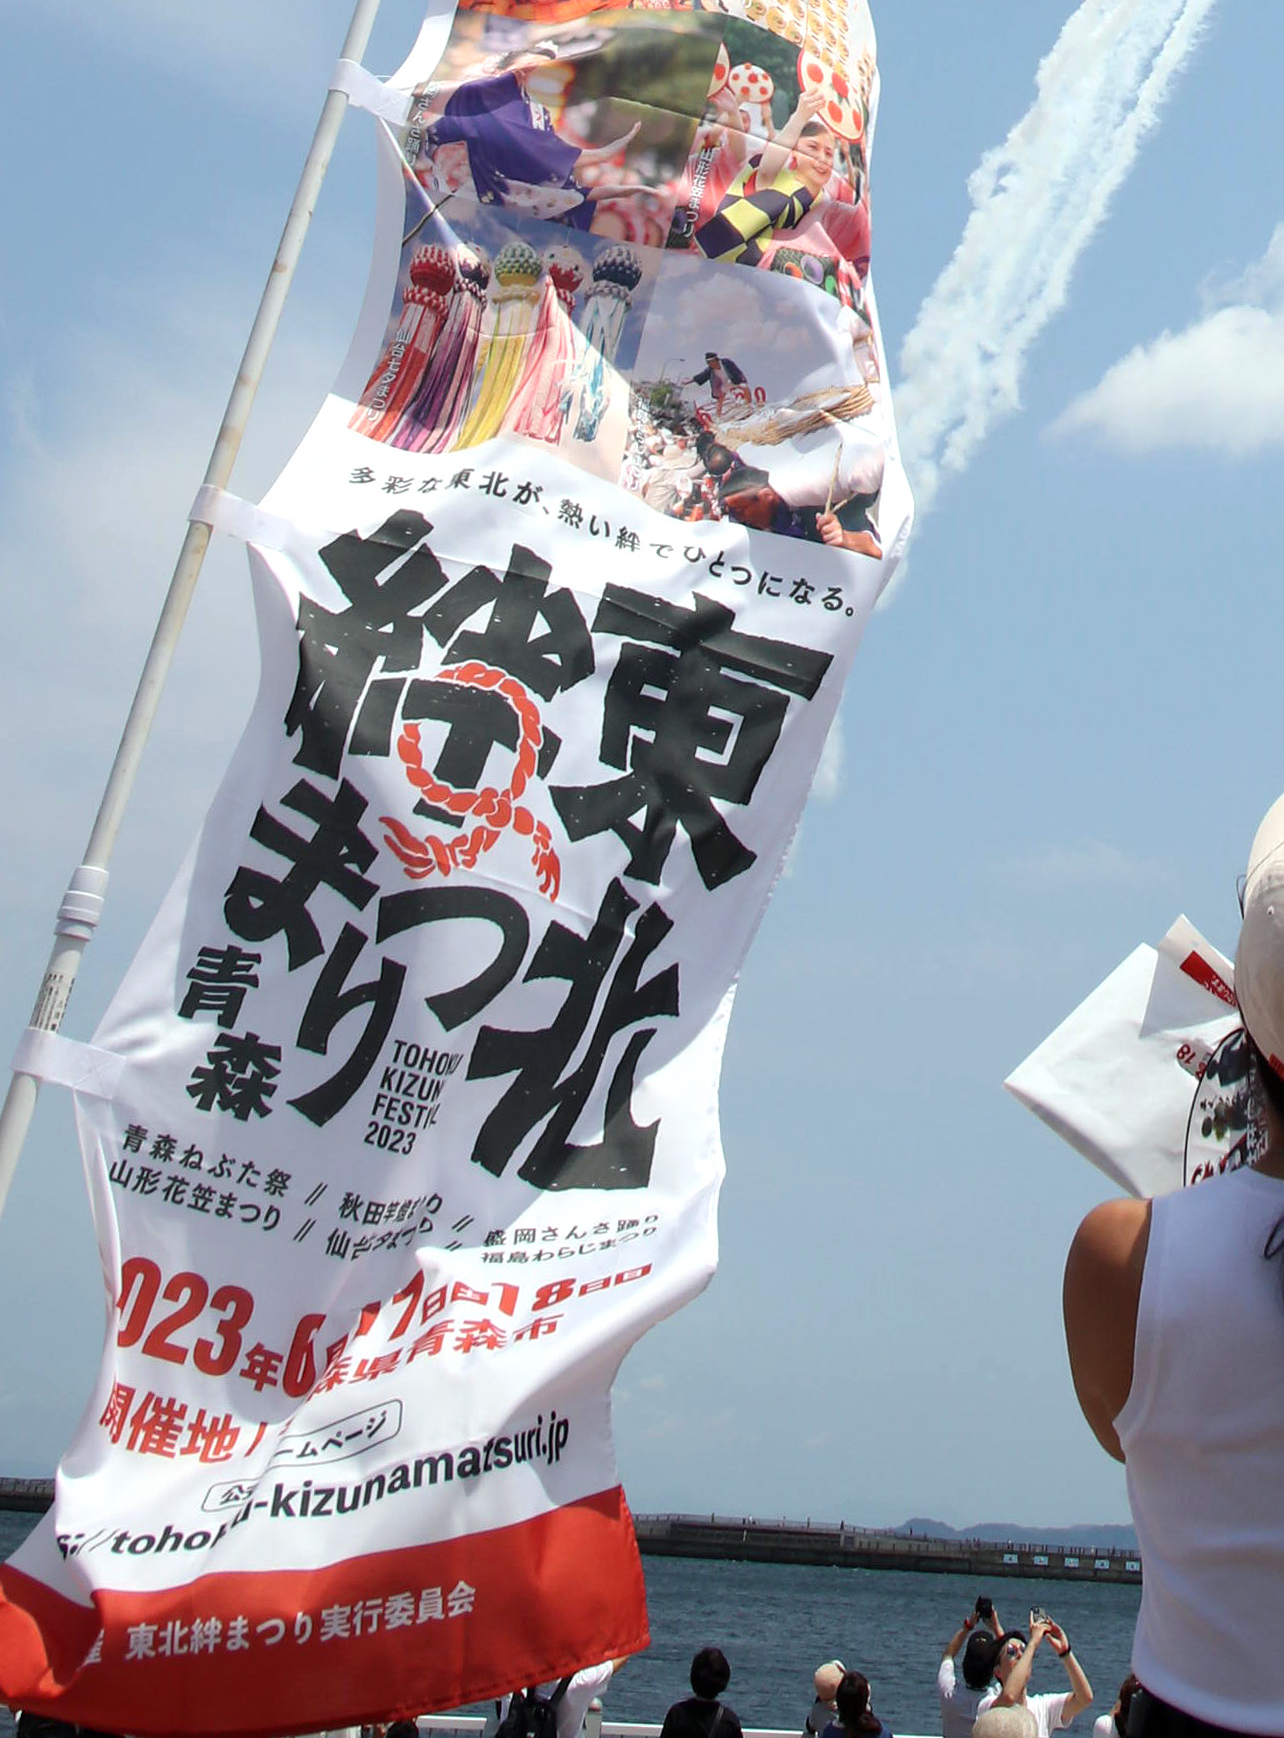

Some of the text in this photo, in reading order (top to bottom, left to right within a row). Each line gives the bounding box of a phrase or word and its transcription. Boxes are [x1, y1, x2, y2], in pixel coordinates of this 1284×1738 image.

[178, 944, 283, 1122] 青森
[121, 1123, 292, 1198] 青森ねぶた祭
[363, 1120, 417, 1155] 2023
[108, 1158, 282, 1232] 山形花笠まつり
[124, 1579, 477, 1662] 東北絆まつり実行委員会
